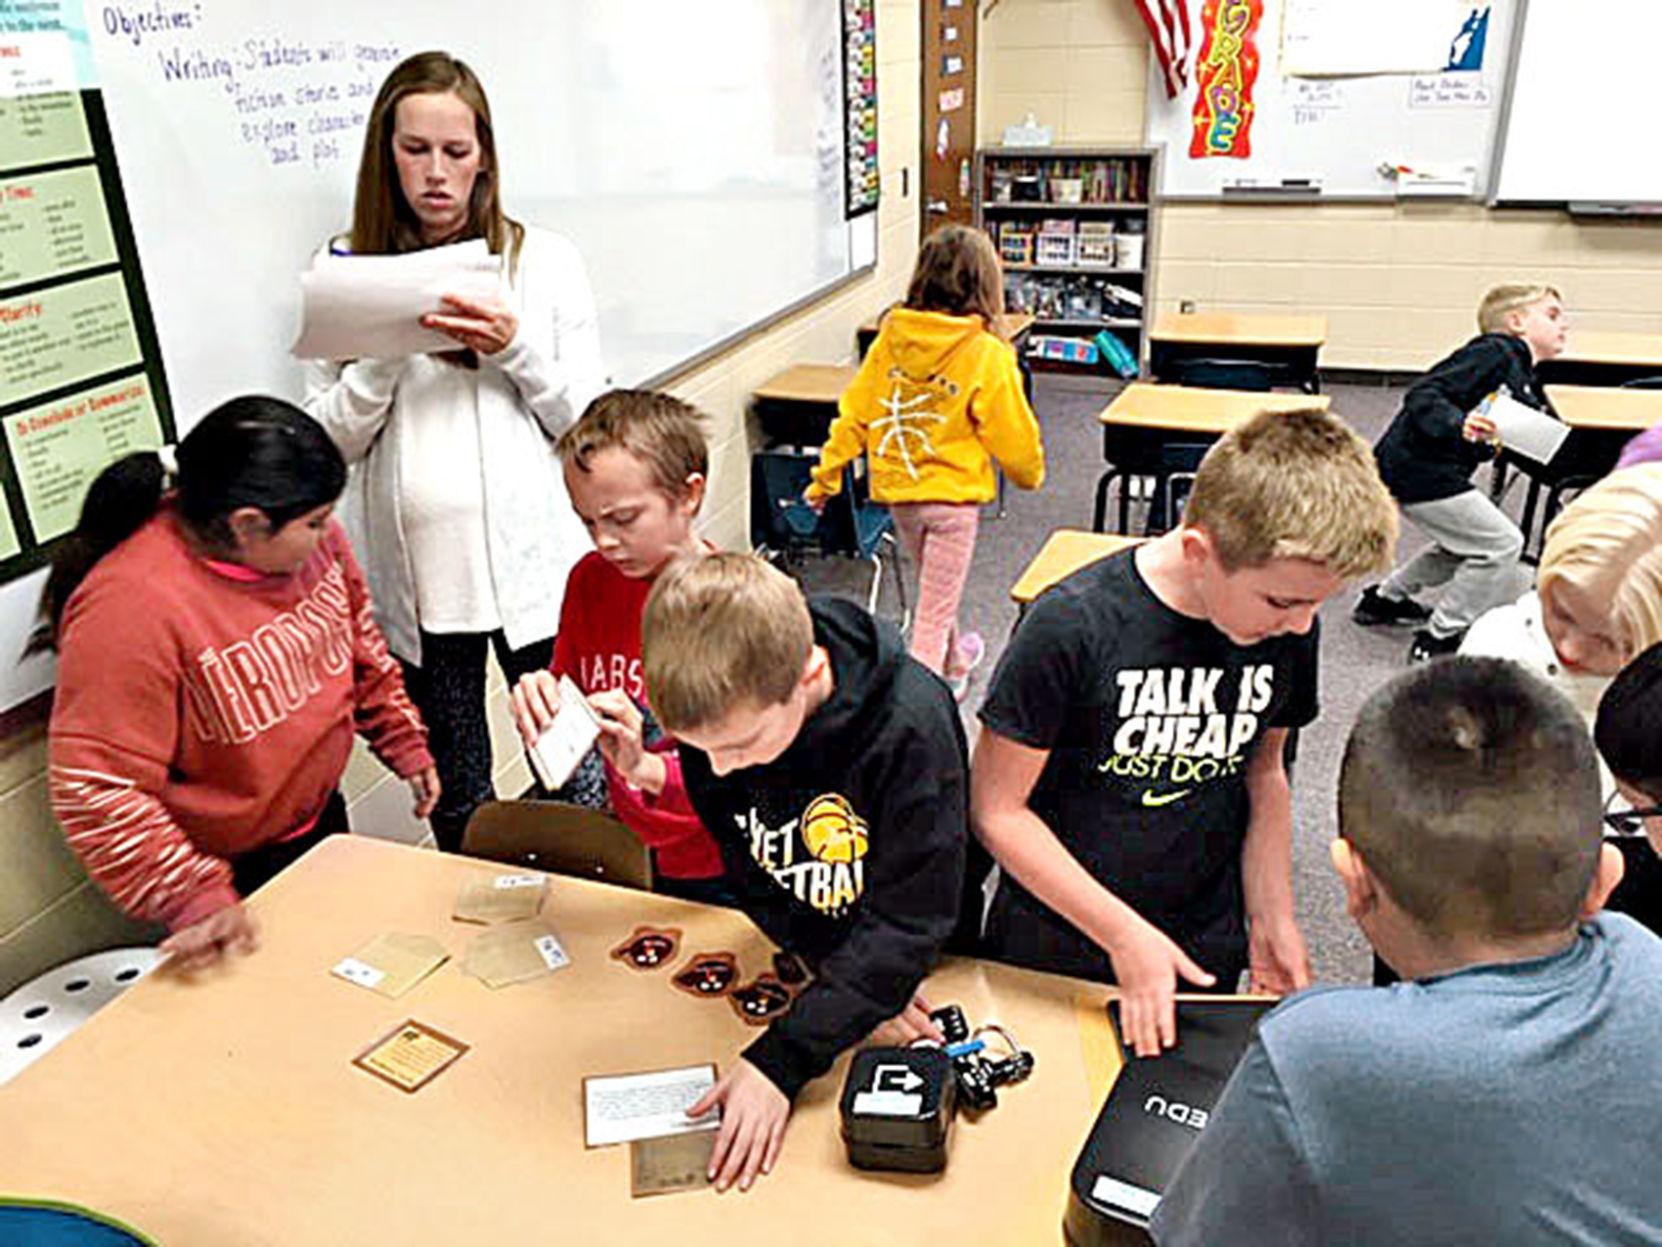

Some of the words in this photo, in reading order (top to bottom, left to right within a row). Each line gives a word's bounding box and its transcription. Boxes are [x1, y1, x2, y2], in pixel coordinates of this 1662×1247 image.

[103, 3, 201, 45] Objectives:
[1116, 667, 1224, 718] TALK
[1237, 664, 1274, 713] IS
[1113, 713, 1258, 759] CHEAP
[1098, 754, 1168, 779] JUST
[1170, 754, 1219, 783] DO
[1144, 1095, 1209, 1128] EDU
